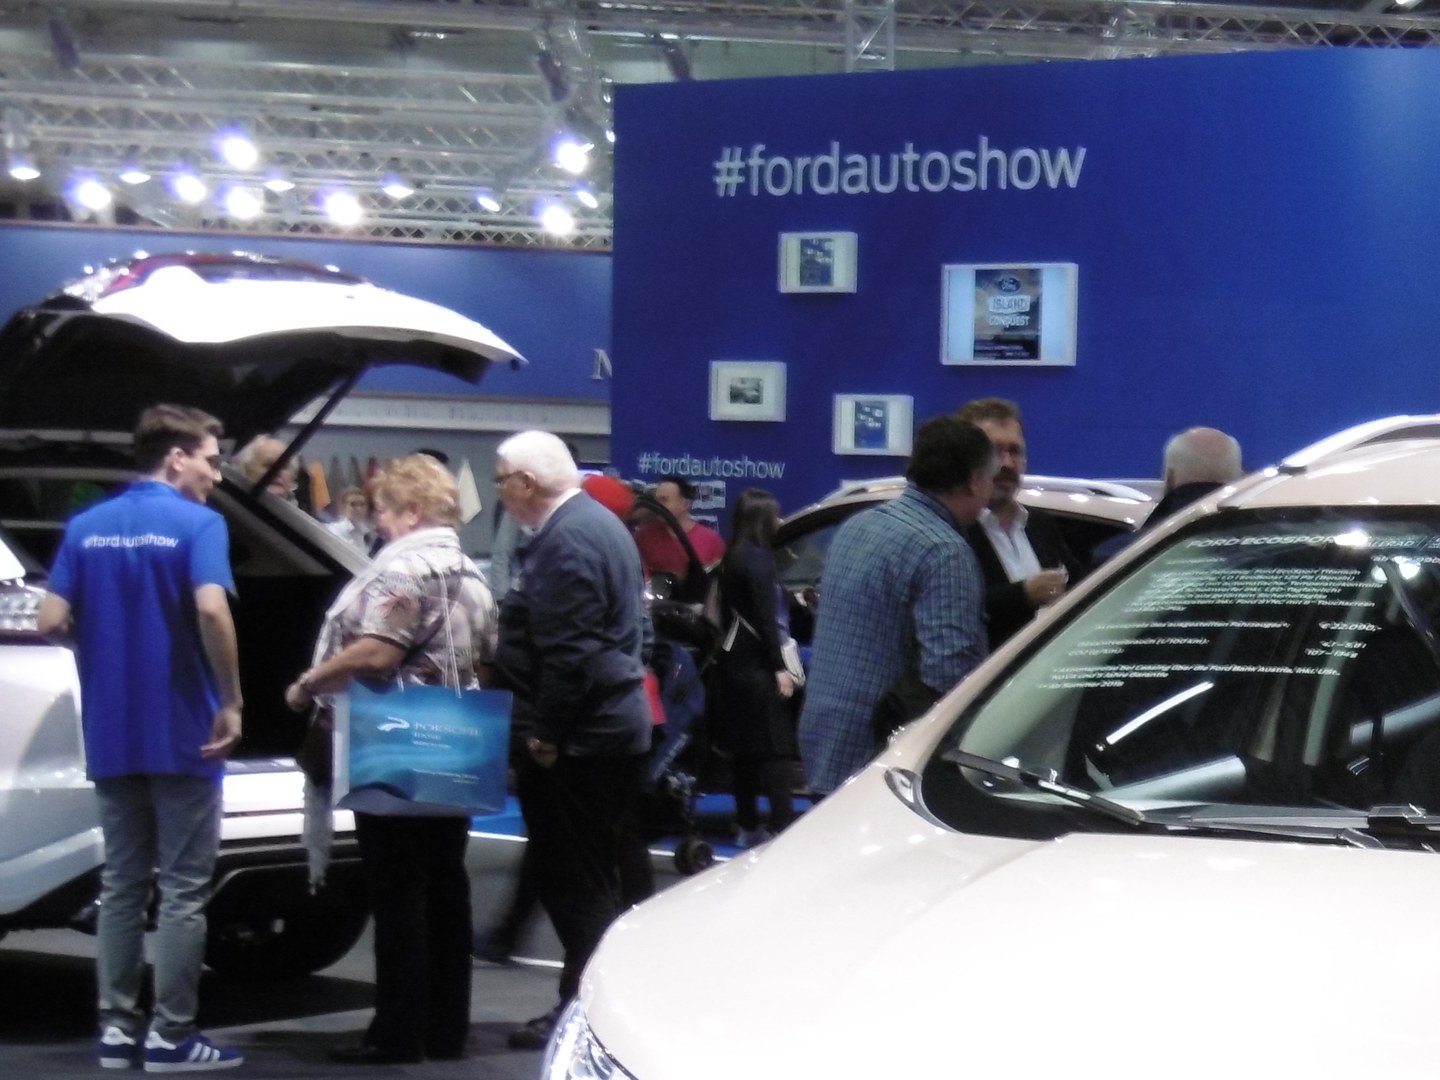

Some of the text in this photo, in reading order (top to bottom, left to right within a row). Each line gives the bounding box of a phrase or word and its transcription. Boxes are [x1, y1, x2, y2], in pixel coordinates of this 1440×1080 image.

[713, 135, 1086, 197] #fordautoshow
[637, 451, 785, 480] #fordautoshow
[1186, 537, 1239, 549] FORD
[1240, 535, 1337, 547] ECOSPOR
